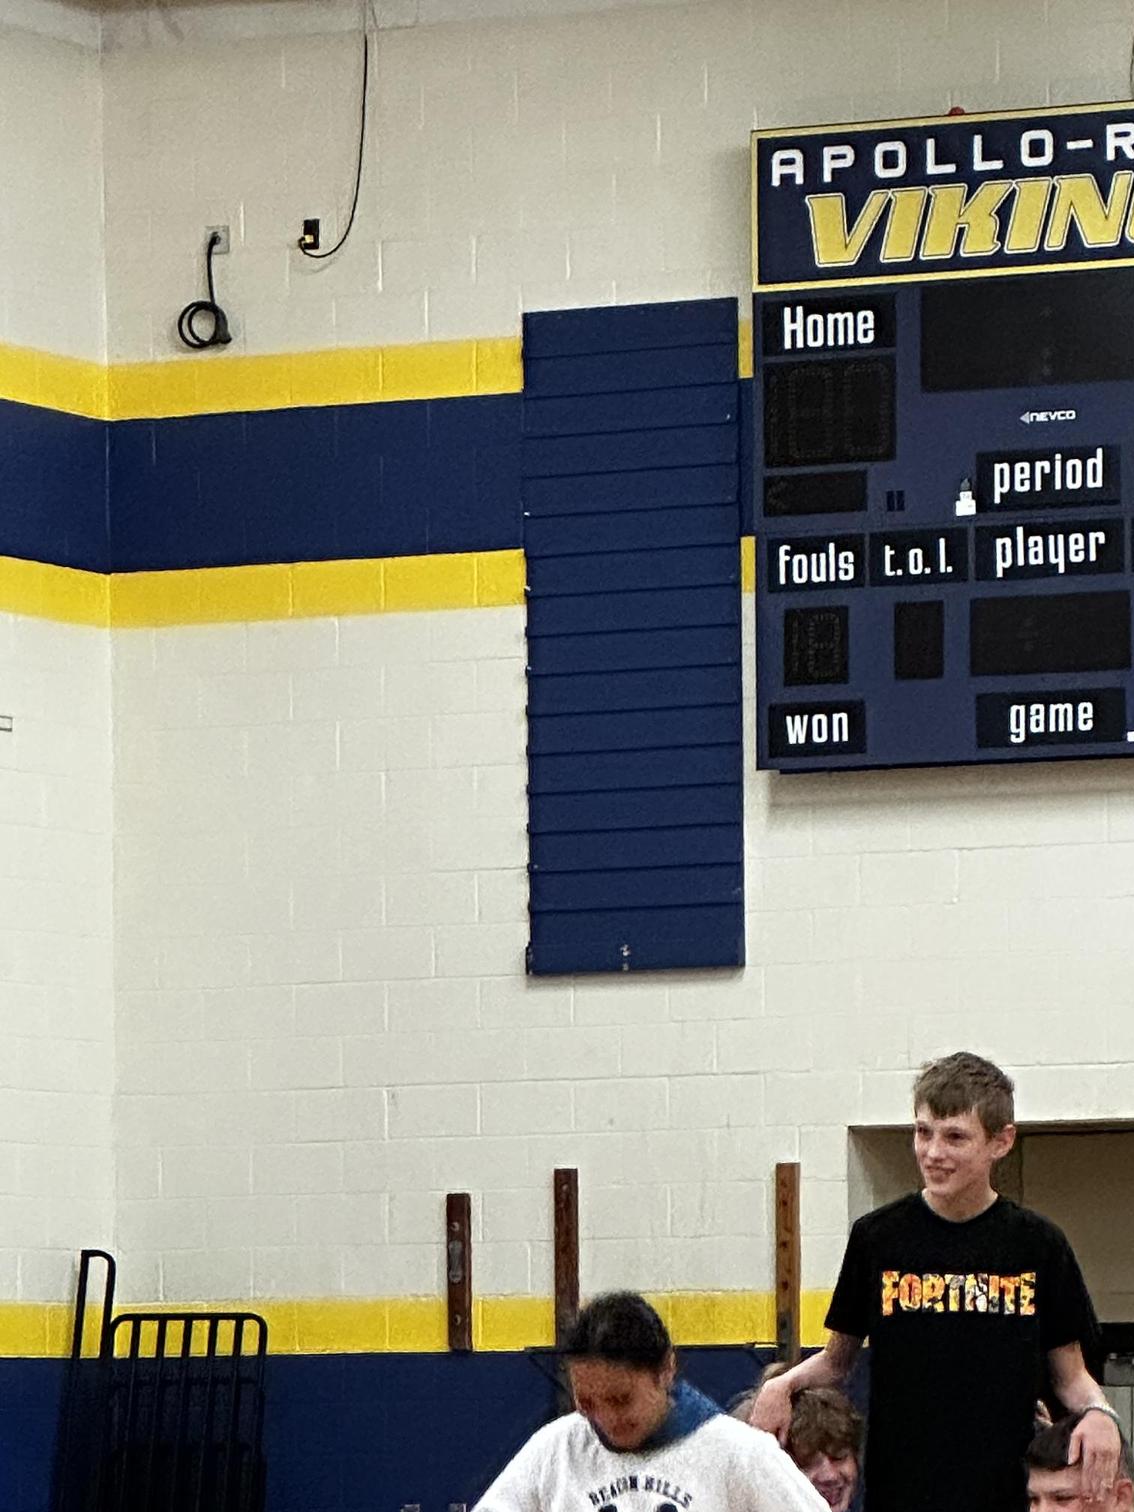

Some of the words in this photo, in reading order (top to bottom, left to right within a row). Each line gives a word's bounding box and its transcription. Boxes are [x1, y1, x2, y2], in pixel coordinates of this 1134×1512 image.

[783, 305, 875, 350] Home
[1030, 410, 1076, 422] NEVCO
[993, 447, 1103, 504] period
[778, 542, 855, 585] fouls
[884, 537, 953, 577] t.o.l.
[995, 526, 1106, 578] player
[785, 712, 849, 745] won
[1009, 701, 1094, 743] game
[882, 1271, 1036, 1316] FORTNITE
